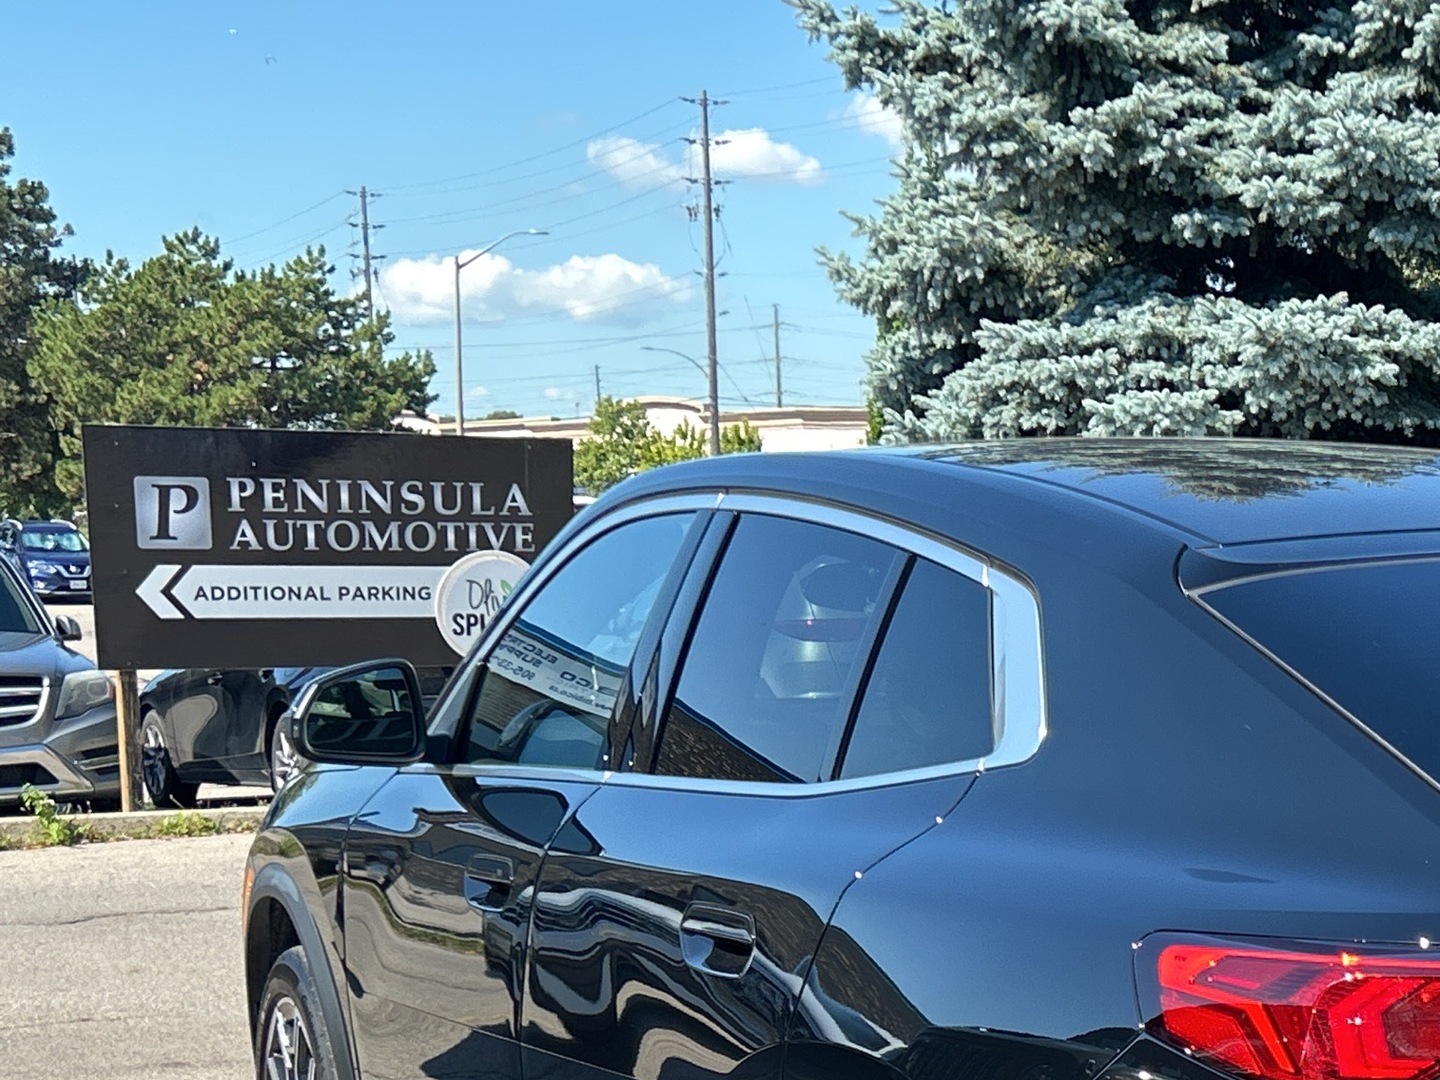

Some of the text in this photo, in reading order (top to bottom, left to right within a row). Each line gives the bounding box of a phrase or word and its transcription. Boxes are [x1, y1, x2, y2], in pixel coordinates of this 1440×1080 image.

[226, 477, 534, 517] PENINSULA
[229, 518, 536, 553] AUTOMOTIVE
[194, 584, 432, 603] ADDITIONAL PARKING
